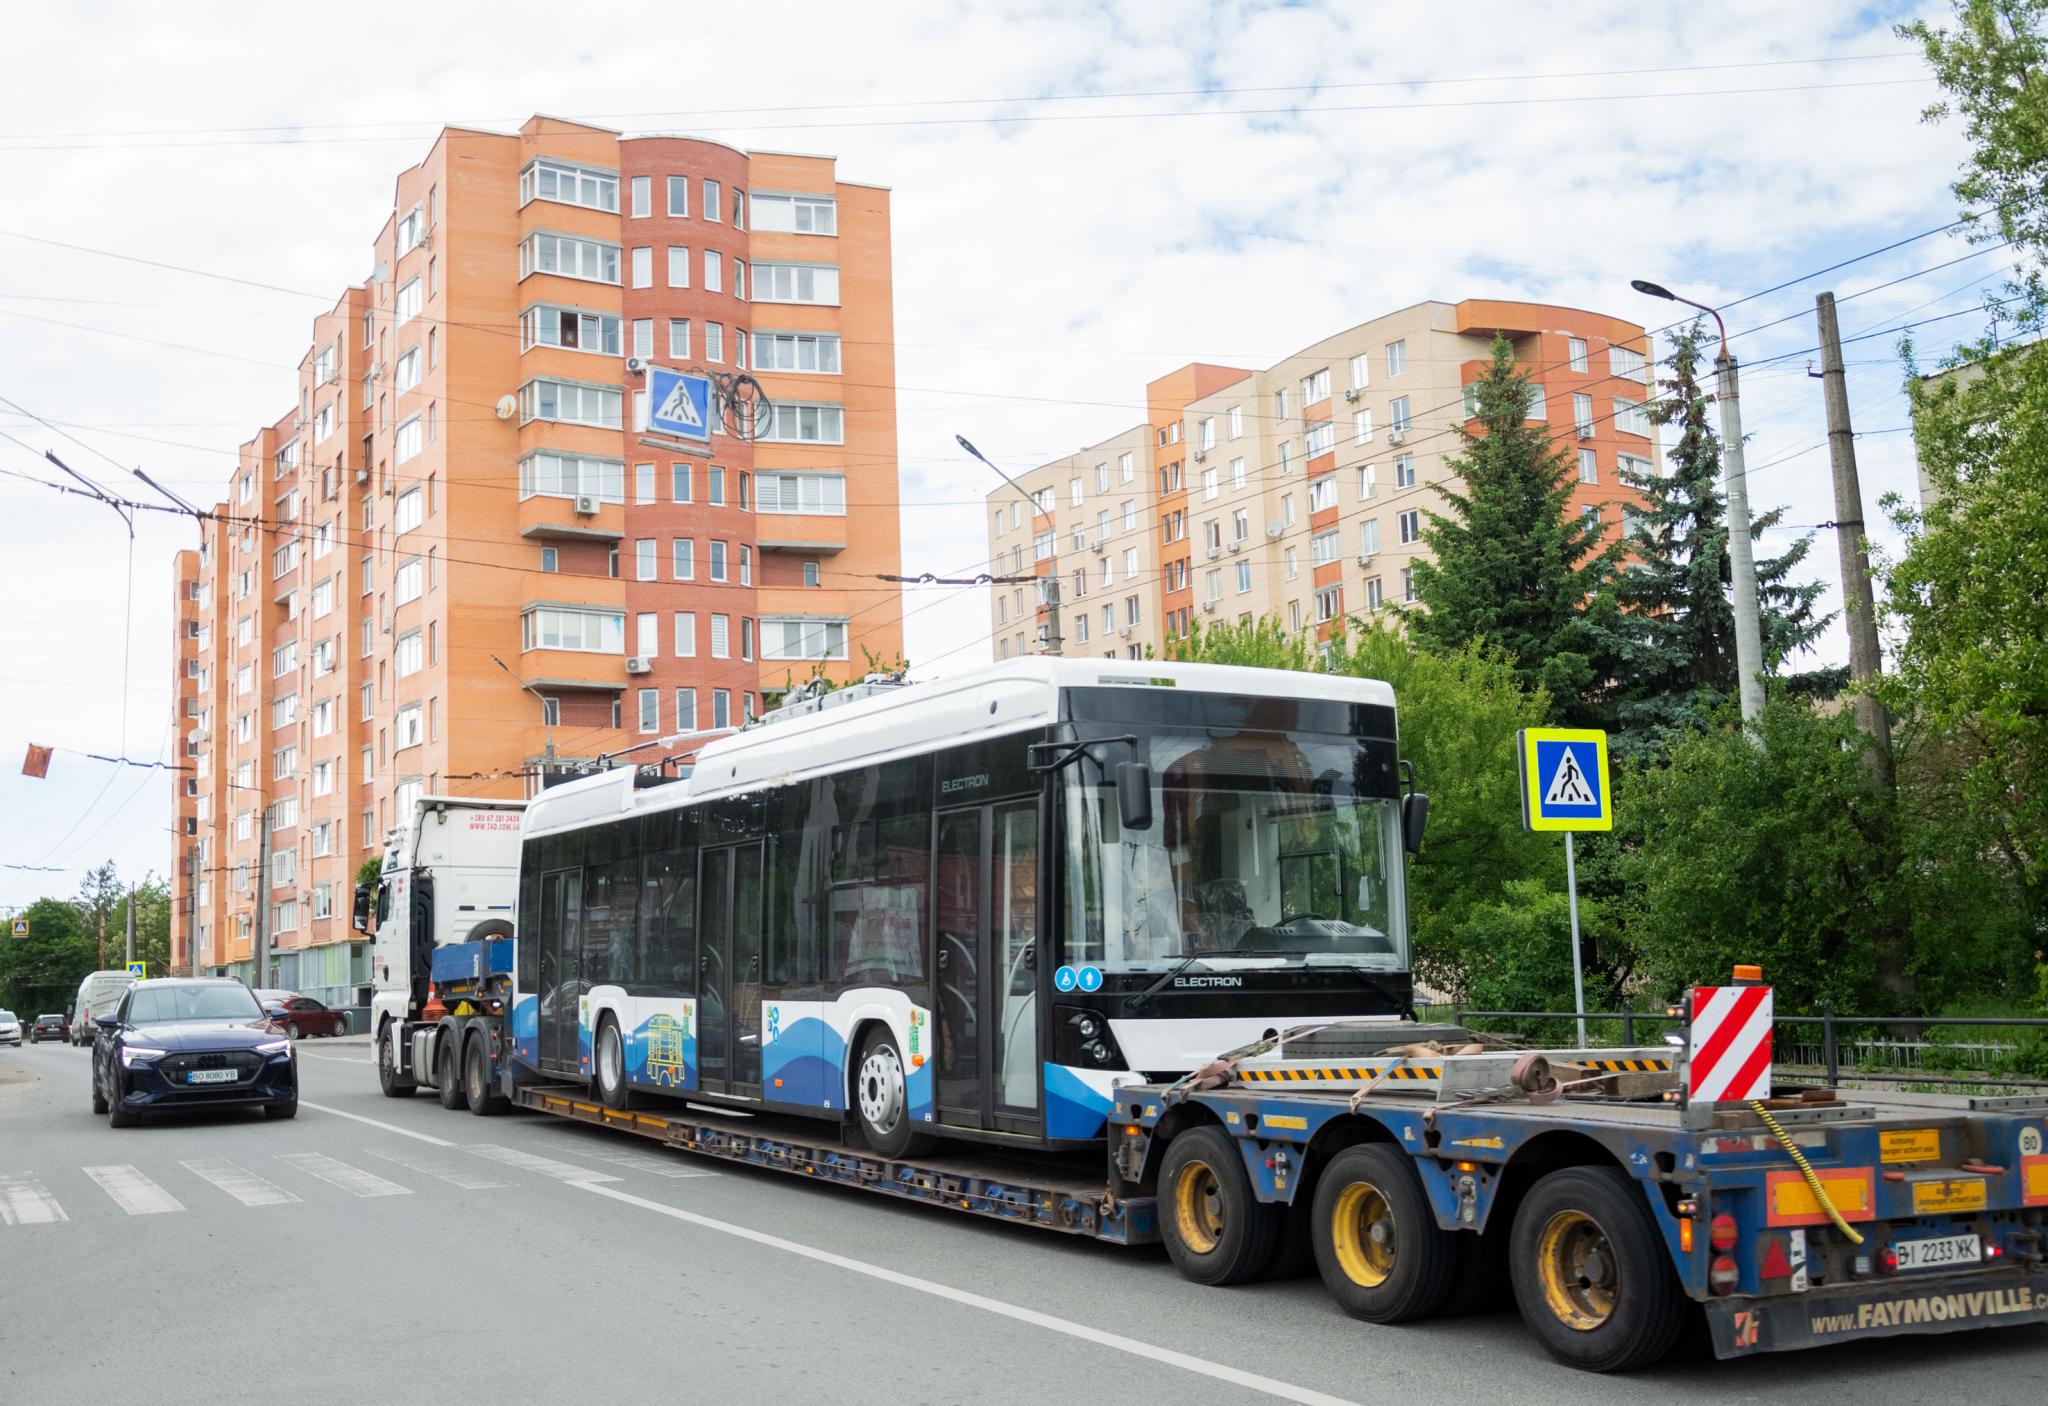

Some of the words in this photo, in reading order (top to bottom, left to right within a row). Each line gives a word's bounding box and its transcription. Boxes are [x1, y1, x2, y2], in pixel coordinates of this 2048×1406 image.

[942, 773, 989, 792] ELECTRON
[469, 823, 520, 831] WWW.TAD.COM.UA
[1174, 977, 1242, 987] ELECTRON
[2023, 1136, 2038, 1150] 80
[1922, 1241, 1953, 1263] 2233
[1954, 1238, 1977, 1260] XK
